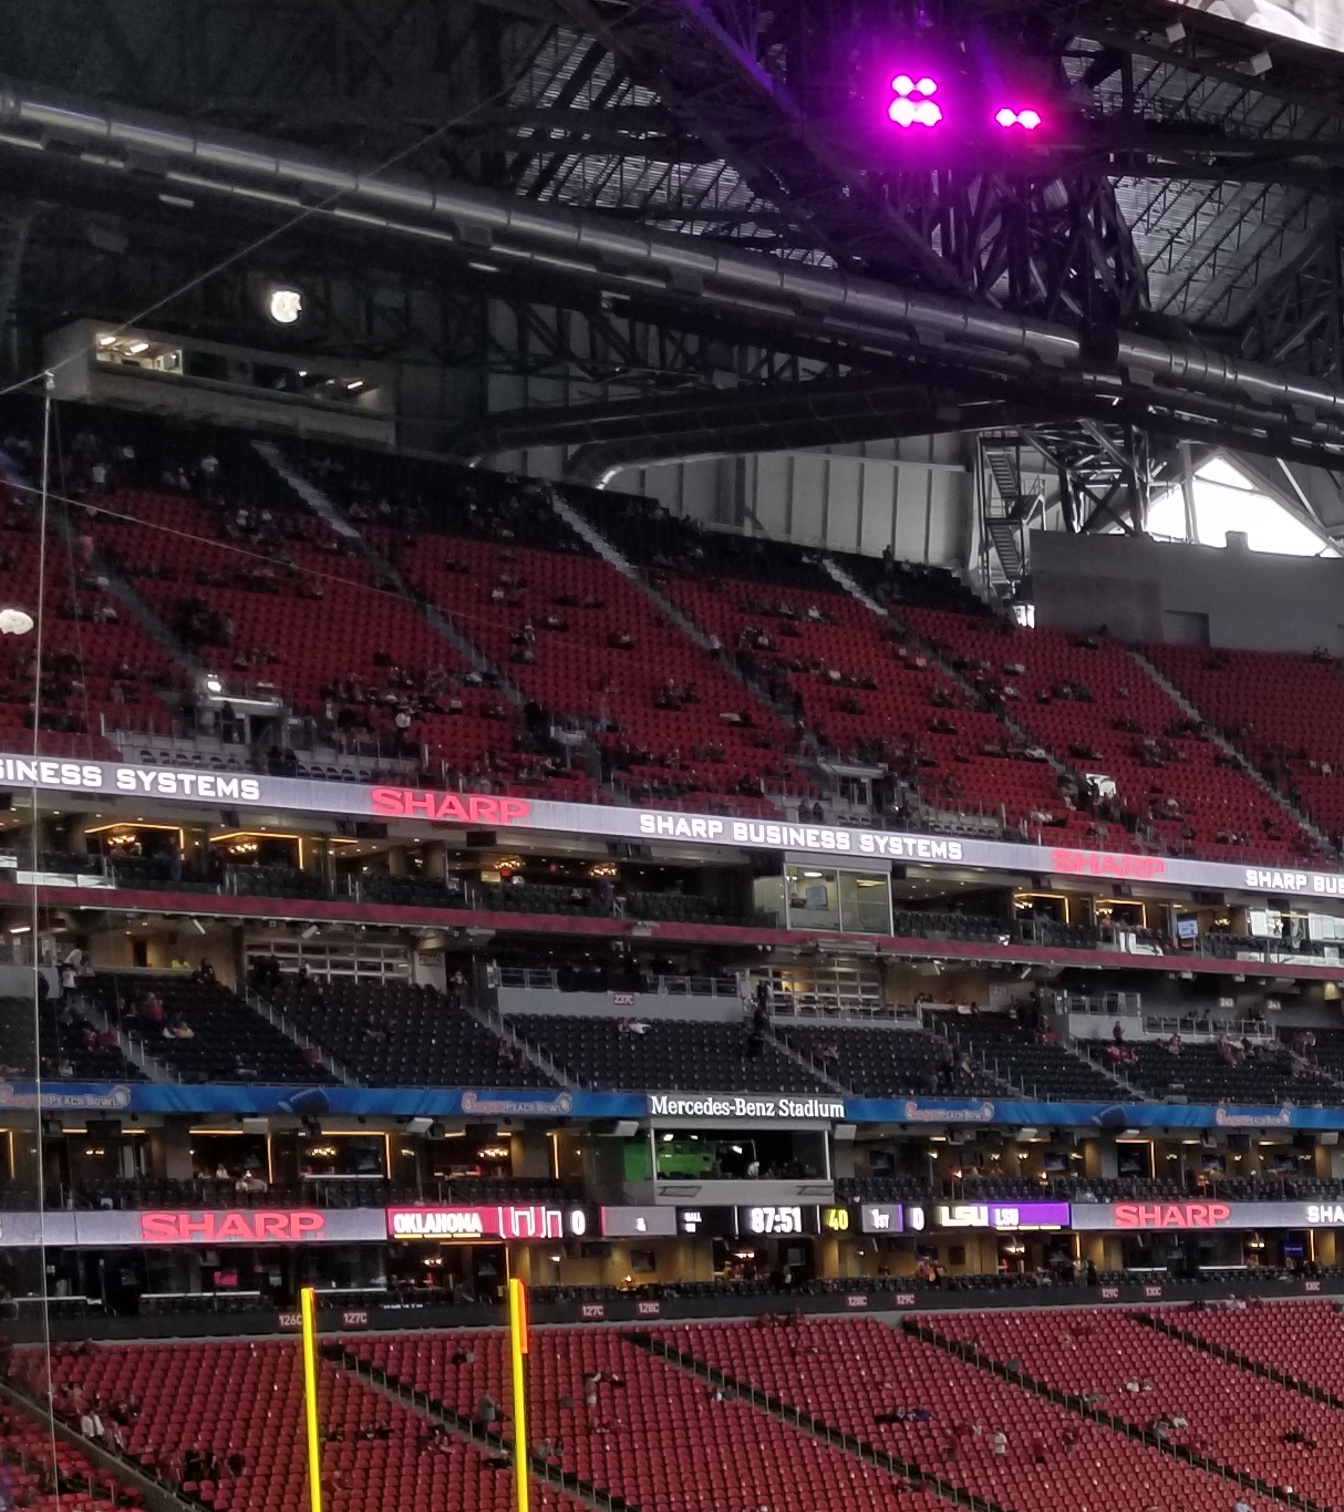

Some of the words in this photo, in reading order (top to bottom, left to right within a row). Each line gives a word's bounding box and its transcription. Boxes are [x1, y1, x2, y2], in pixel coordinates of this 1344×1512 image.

[0, 759, 102, 787] INESS
[116, 768, 260, 800] SYSTEMS
[370, 788, 531, 824] SHARP
[640, 814, 723, 839] SHARP
[732, 823, 851, 850] BUSINESS
[859, 833, 962, 860] SYSTEMS
[1051, 849, 1166, 878] SHARP
[1245, 869, 1307, 891] SHARP
[650, 1096, 775, 1118] Mercedes-Benz
[778, 1098, 845, 1119] Stadium
[140, 1210, 326, 1242] SHARP
[393, 1212, 484, 1233] OKLAHOMA
[570, 1210, 587, 1235] 0
[750, 1206, 802, 1233] 87:51
[829, 1209, 849, 1231] 40
[940, 1206, 989, 1227] LSU
[1114, 1203, 1231, 1228] SHARP
[343, 1312, 367, 1324] 127C
[582, 1305, 604, 1317] 127C
